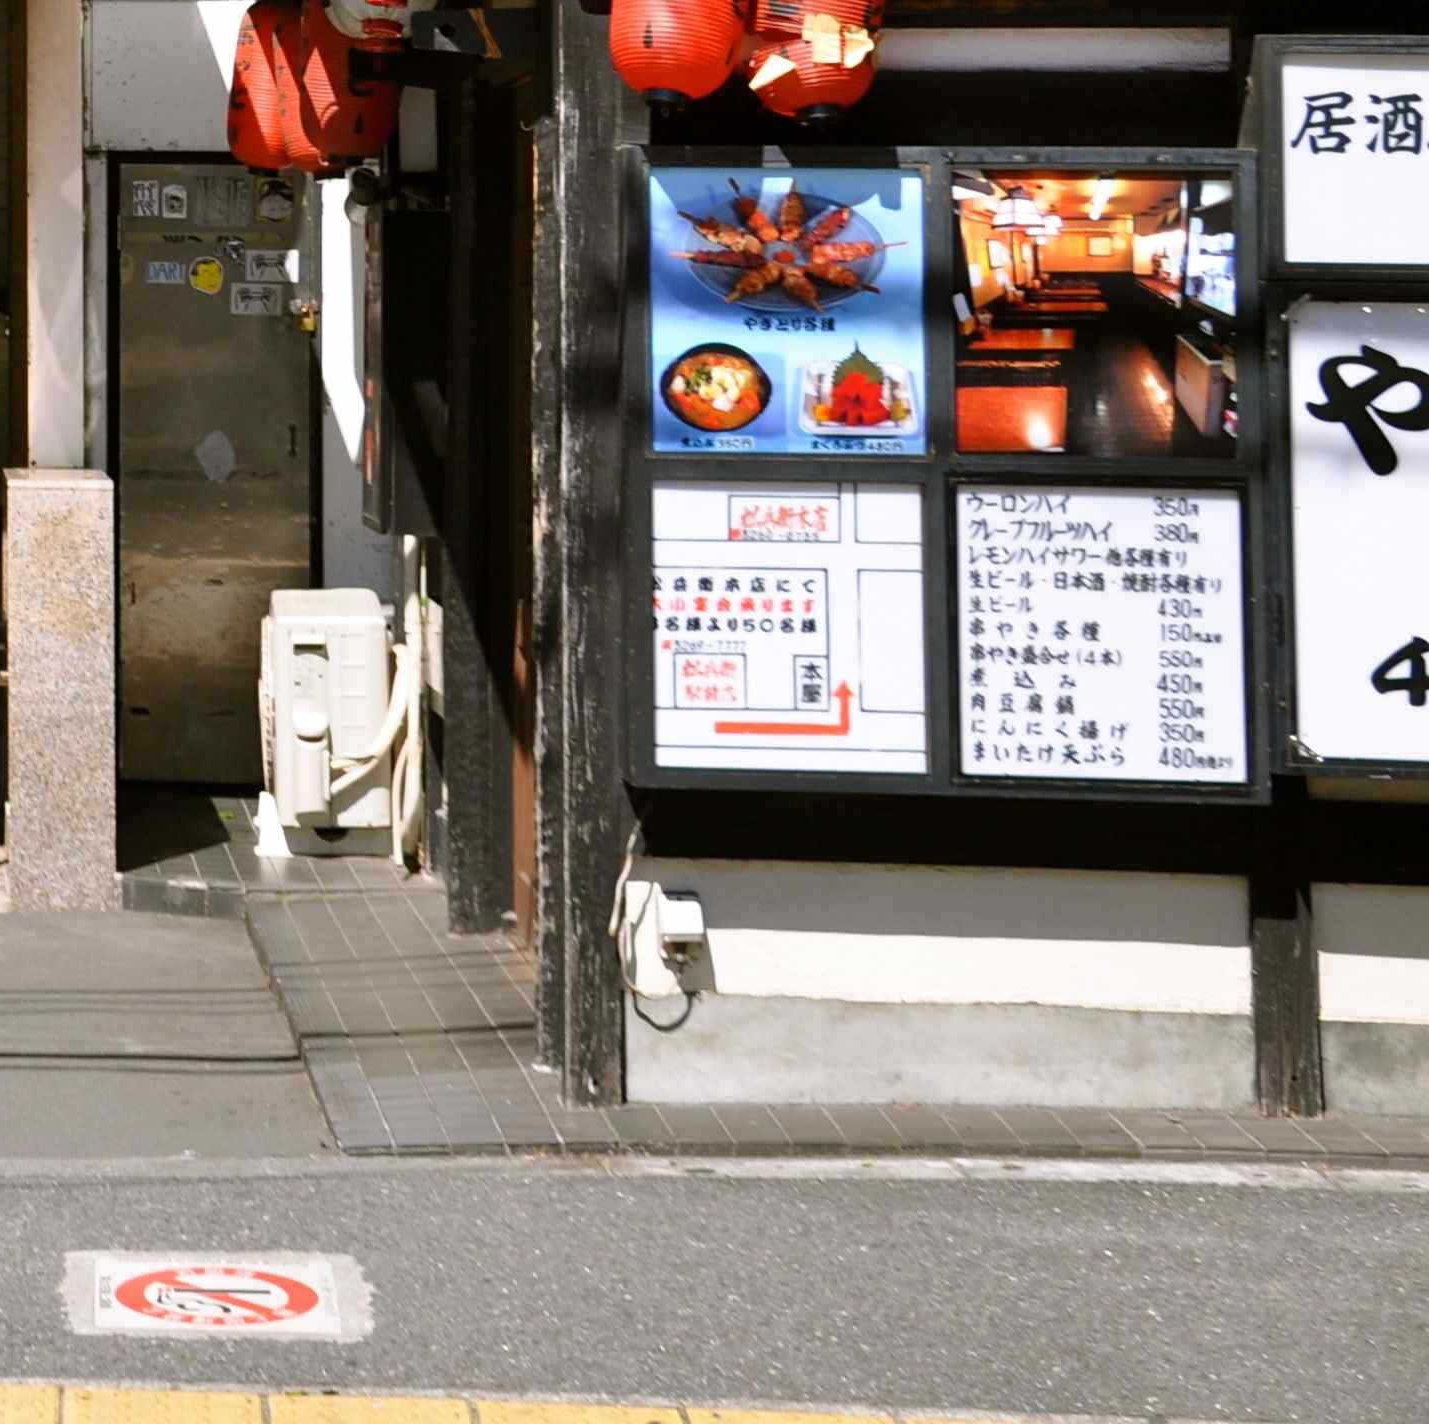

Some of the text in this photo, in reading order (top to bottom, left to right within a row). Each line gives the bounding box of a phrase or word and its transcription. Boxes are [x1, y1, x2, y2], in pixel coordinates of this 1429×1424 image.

[1291, 91, 1429, 156] 居酒
[967, 493, 1072, 515] ウーロンハイ
[969, 597, 1034, 616] 生ビール
